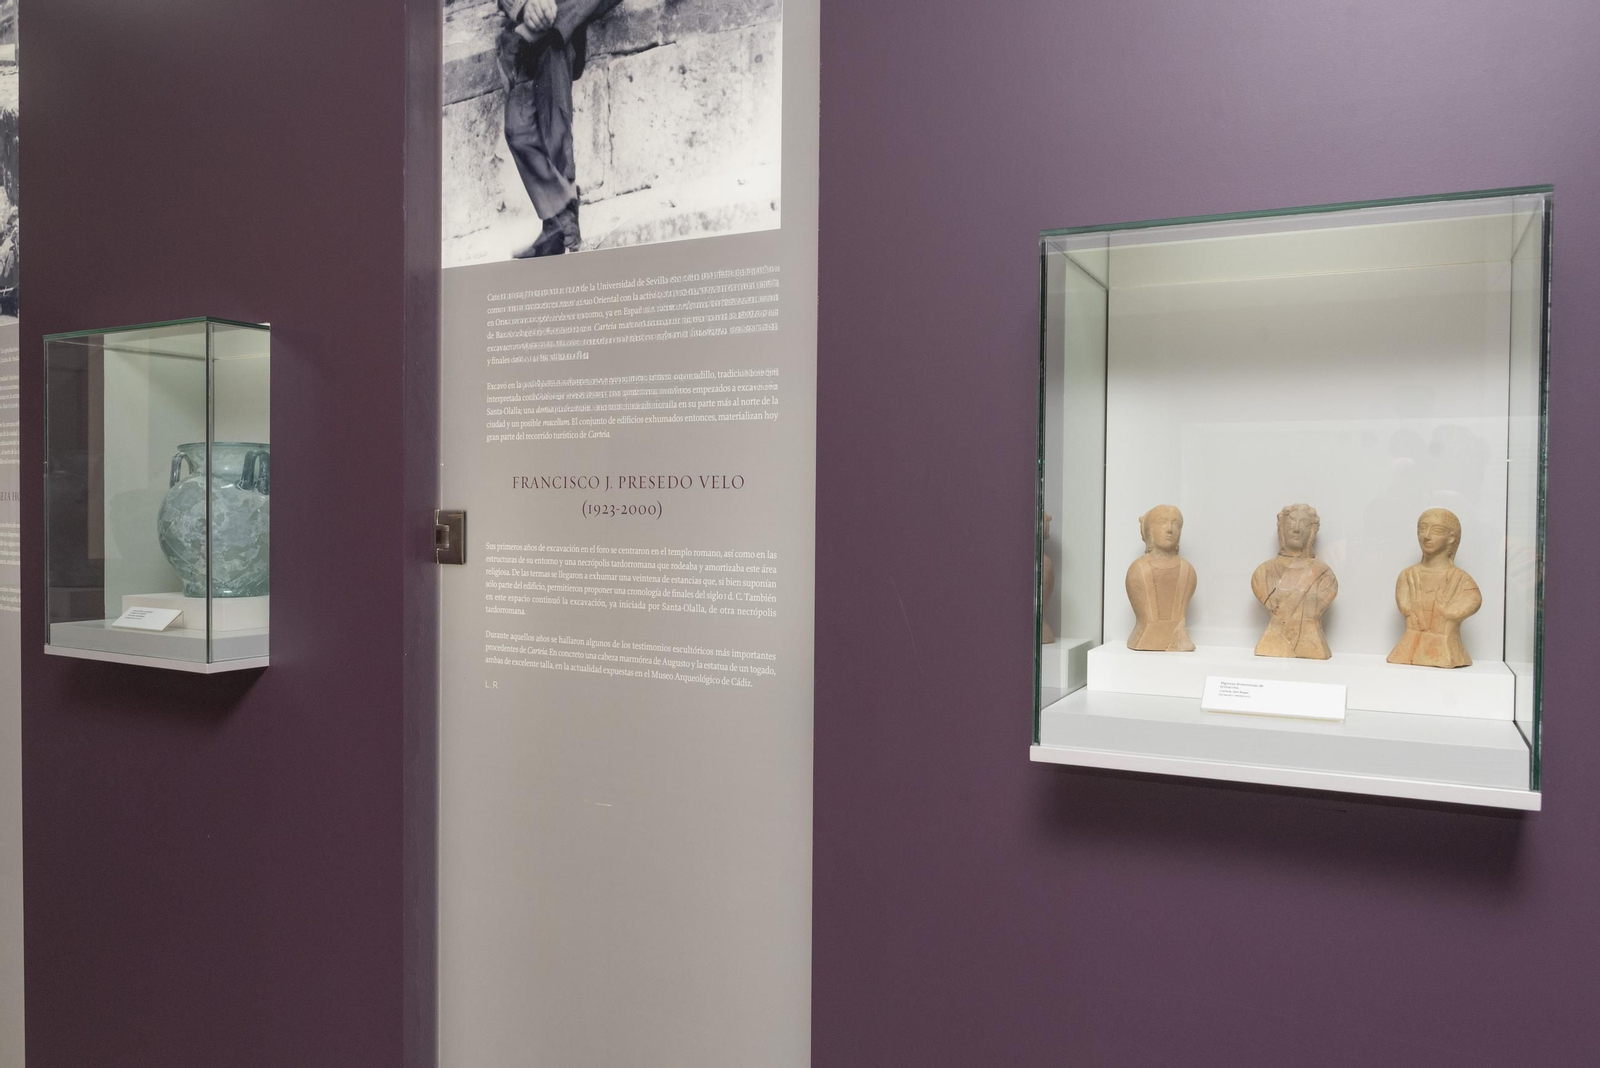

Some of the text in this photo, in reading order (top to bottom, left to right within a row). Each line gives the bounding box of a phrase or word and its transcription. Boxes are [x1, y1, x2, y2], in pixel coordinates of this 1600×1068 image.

[698, 399, 716, 410] parte
[717, 398, 731, 407] más
[741, 398, 760, 406] norte
[762, 396, 770, 405] de
[772, 396, 778, 405] la
[487, 420, 505, 428] ciudad
[521, 419, 541, 429] posible
[572, 417, 578, 425] El
[579, 417, 606, 427] conjunto
[608, 416, 615, 424] de
[617, 416, 643, 424] edificios
[645, 414, 683, 423] exhumados
[718, 412, 762, 421] materializan
[765, 411, 778, 422] hoy
[487, 434, 499, 443] gran
[500, 433, 514, 442] parte
[526, 431, 552, 439] recorrido
[554, 431, 578, 439] turístico
[513, 475, 744, 492] FRANCISCO J. PRESEDO VELO
[582, 500, 662, 520] (1923-2000)
[497, 543, 522, 552] primeros
[524, 543, 537, 551] años
[547, 544, 579, 552] excavación
[590, 545, 595, 553] el
[597, 545, 609, 553] foro
[618, 547, 649, 555] centraron
[660, 547, 666, 555] el
[668, 548, 692, 558] templo
[724, 549, 733, 557] así
[767, 550, 777, 559] las
[578, 558, 610, 569] necrópolis
[612, 559, 655, 568] tardorromana
[657, 563, 669, 571] que
[671, 561, 697, 570] rodeaba
[705, 563, 744, 572] amortizaba
[746, 564, 760, 572] este
[762, 564, 776, 573] área
[559, 570, 583, 581] llegaron
[589, 572, 617, 580] exhumar
[632, 574, 660, 582] veintena
[662, 574, 670, 583] de
[671, 576, 701, 584] estancias
[726, 577, 741, 586] bien
[743, 579, 776, 590] suponían
[499, 581, 512, 590] parte
[514, 581, 522, 589] del
[547, 584, 582, 593] permitieron
[584, 587, 612, 596] proponer
[627, 587, 661, 598] cronología
[663, 588, 670, 597] de
[672, 589, 693, 598] finales
[695, 590, 705, 598] del
[707, 591, 723, 602] siglo
[744, 592, 776, 602] También
[508, 595, 530, 604] espacio
[532, 596, 560, 604] continuó
[562, 596, 568, 604] la
[609, 601, 617, 610] ya
[619, 600, 645, 609] iniciada
[648, 603, 660, 612] por
[709, 604, 717, 613] de
[720, 606, 734, 614] otra
[737, 607, 776, 618] necrópolis
[486, 630, 776, 660] Durante aquellos años hallaron algunos de los testimonios escultóricos más importantes
[486, 644, 518, 653] procedentes
[519, 645, 526, 653] de
[549, 648, 557, 656] En
[598, 652, 618, 661] cabeza
[619, 655, 652, 664] marmórea
[653, 656, 661, 665] de
[662, 657, 690, 669] Augusto
[697, 660, 702, 669] la
[704, 662, 728, 671] estatua
[729, 663, 738, 672] de
[485, 656, 503, 664] ambas
[512, 658, 538, 667] excelente
[564, 662, 569, 670] la
[570, 664, 602, 673] actualidad
[603, 668, 633, 677] expuestas
[651, 670, 673, 680] Museo
[675, 672, 720, 686] Arqueológico
[721, 676, 730, 685] de
